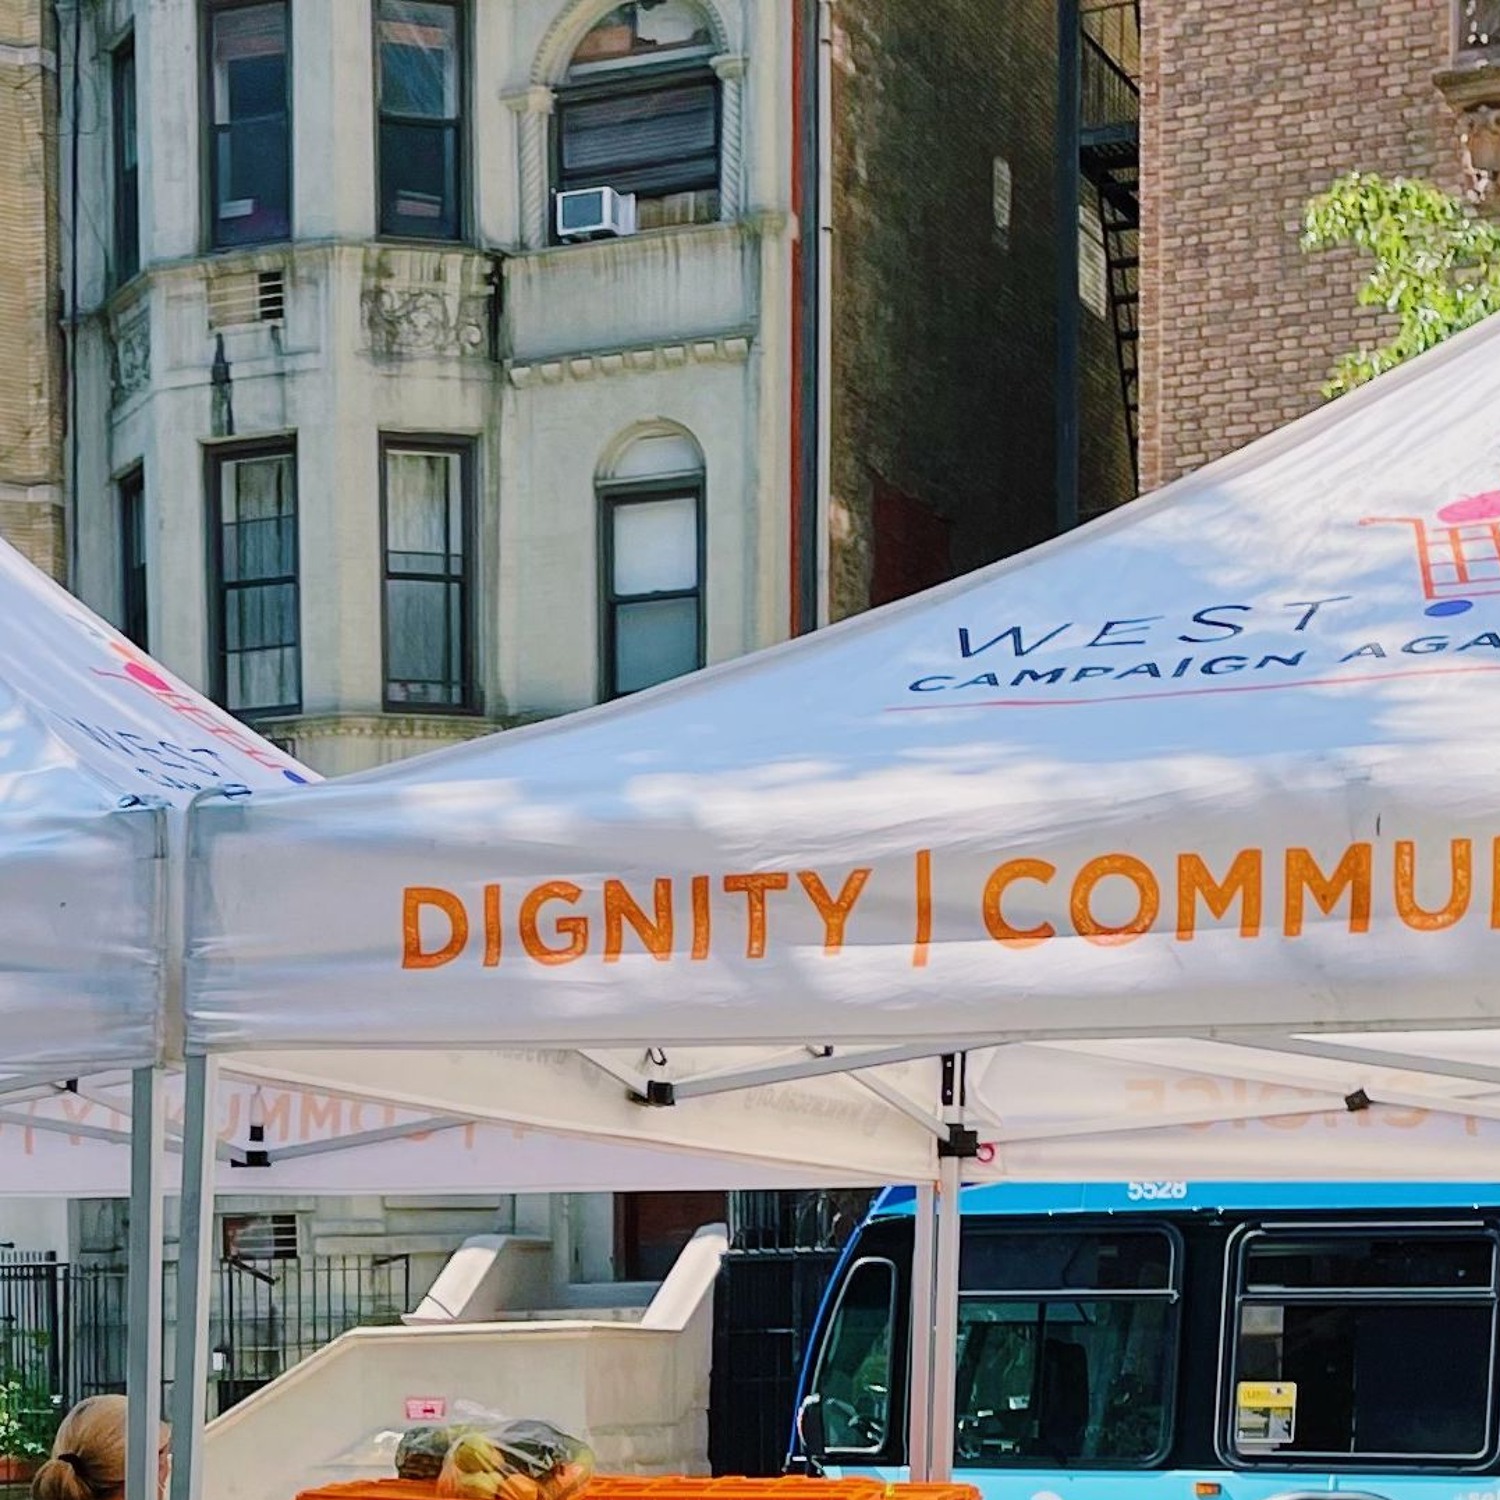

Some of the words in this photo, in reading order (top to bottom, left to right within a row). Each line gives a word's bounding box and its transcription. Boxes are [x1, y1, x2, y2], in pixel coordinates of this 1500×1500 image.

[957, 595, 1353, 659] WEST
[908, 650, 1306, 693] CAMPAIGN
[402, 868, 870, 969] DIGNITY
